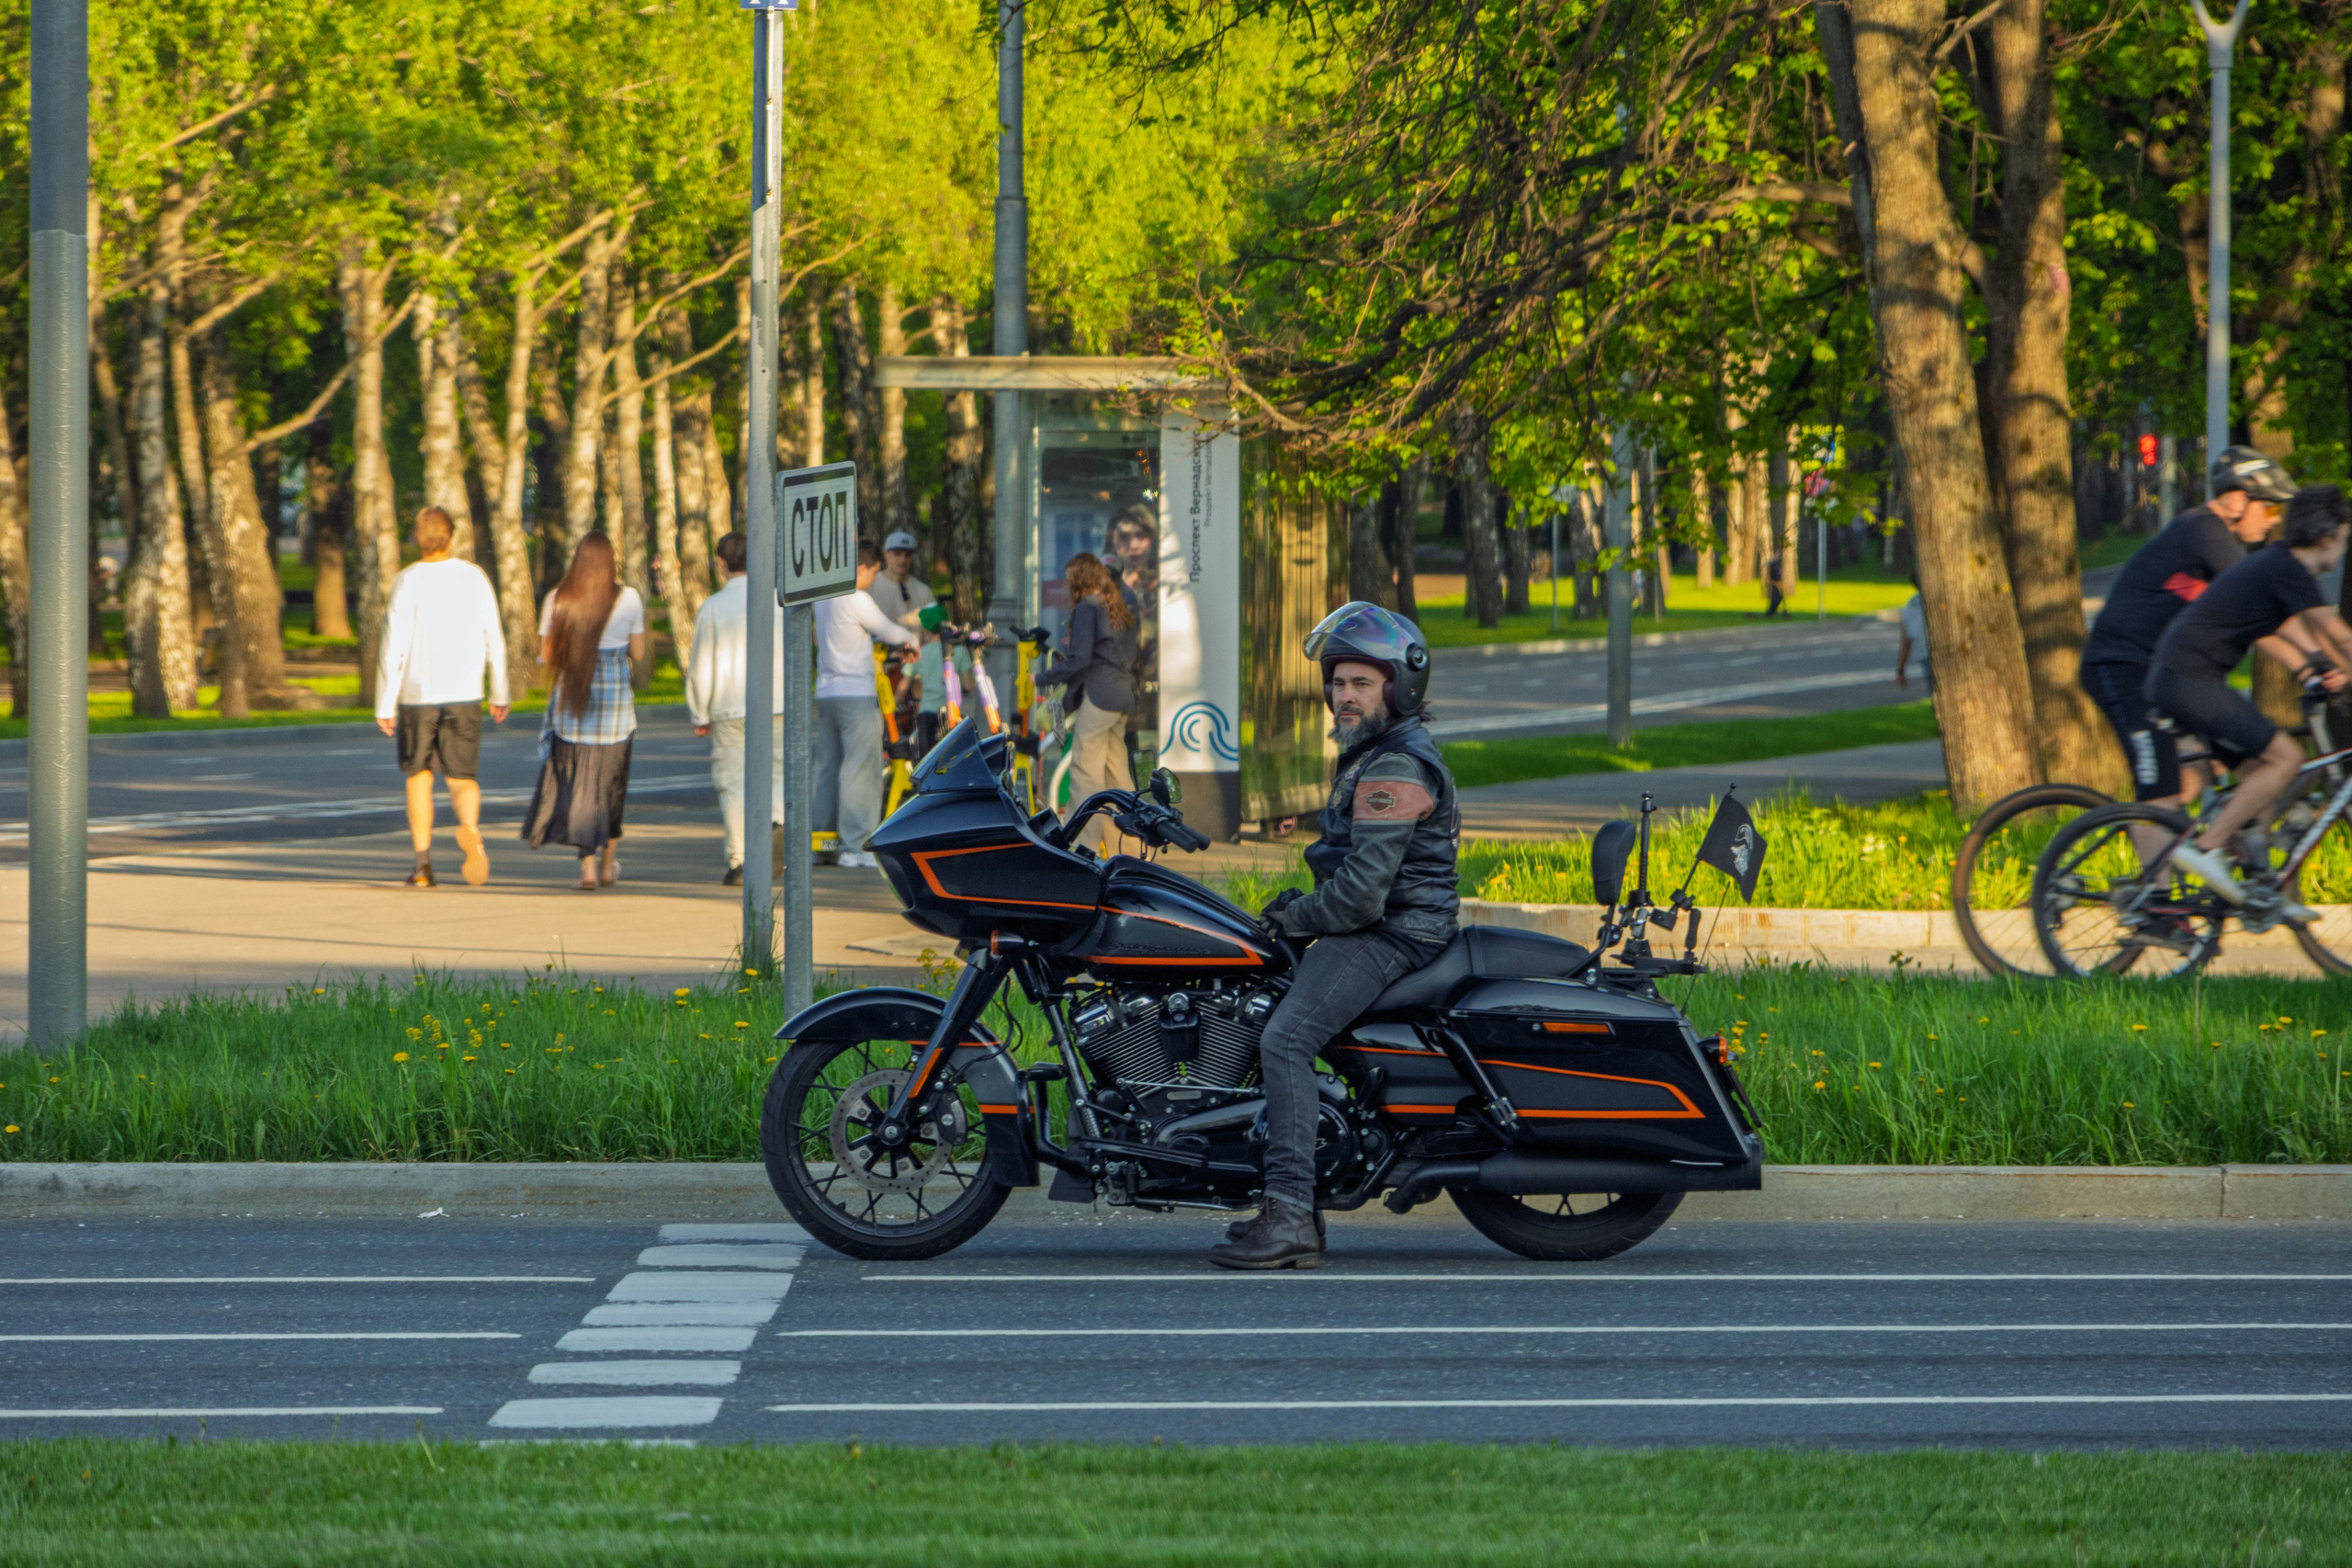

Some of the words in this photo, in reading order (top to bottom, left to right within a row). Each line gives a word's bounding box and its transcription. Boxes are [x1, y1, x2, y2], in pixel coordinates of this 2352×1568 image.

[1189, 429, 1203, 514] Вернадскоо
[1204, 488, 1213, 527] Prospekt
[791, 491, 848, 579] СТОП
[1189, 518, 1203, 582] Проспект
